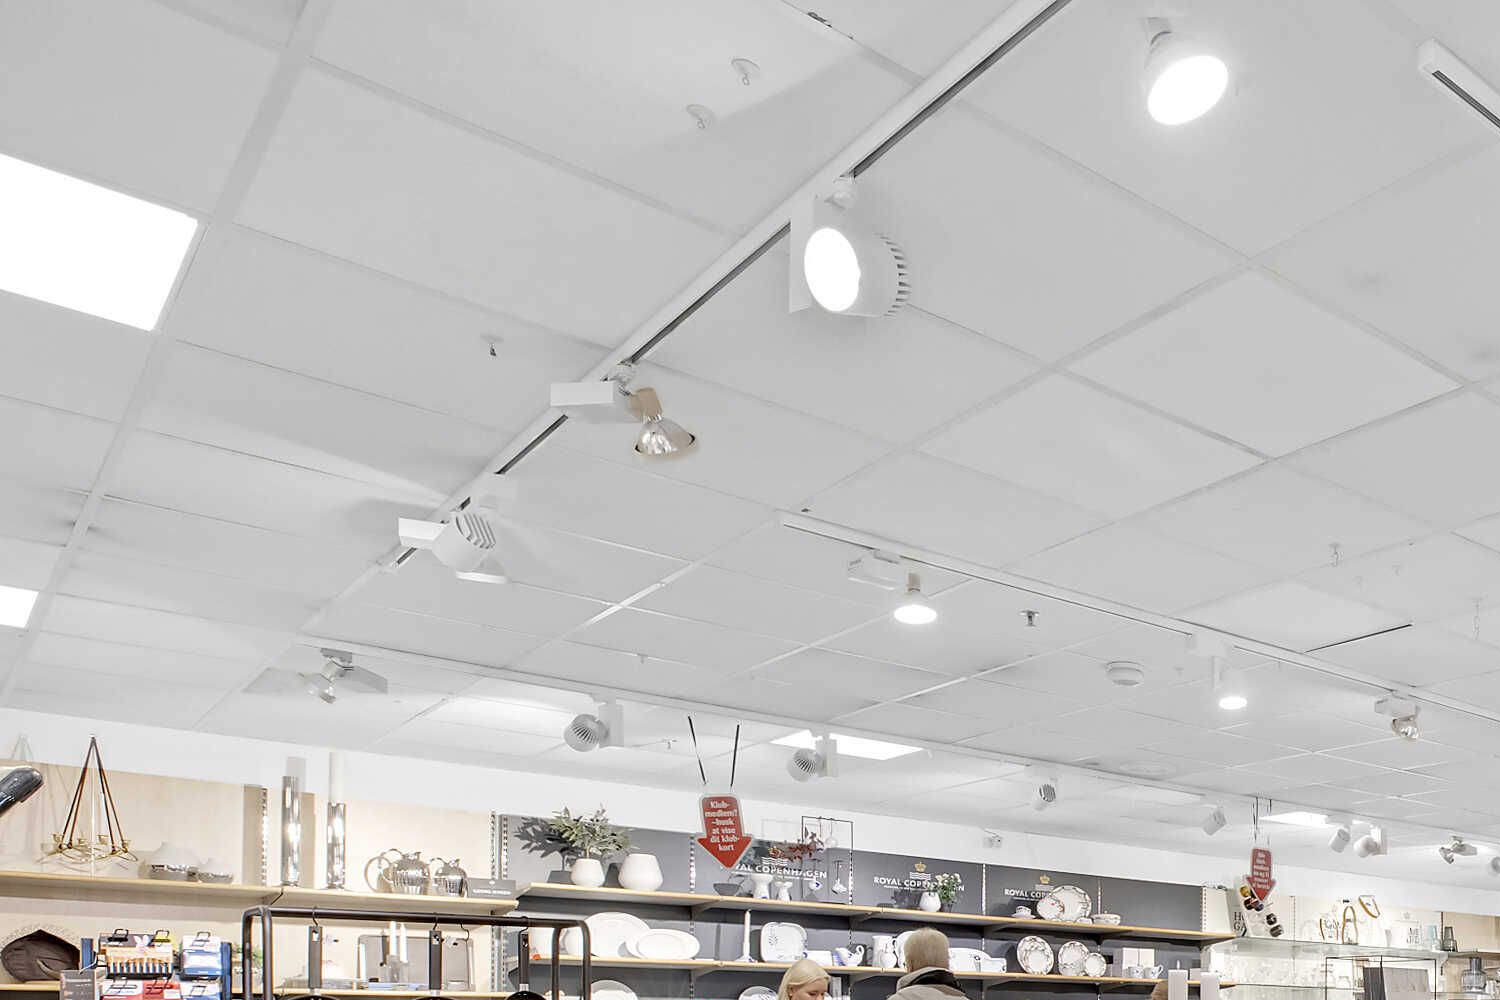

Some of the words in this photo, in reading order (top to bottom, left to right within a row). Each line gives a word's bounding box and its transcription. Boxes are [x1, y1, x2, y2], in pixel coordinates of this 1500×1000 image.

[718, 843, 735, 852] kort
[755, 864, 828, 879] COPENHAGEN
[873, 876, 902, 886] ROYAL
[1004, 888, 1029, 898] ROYAL
